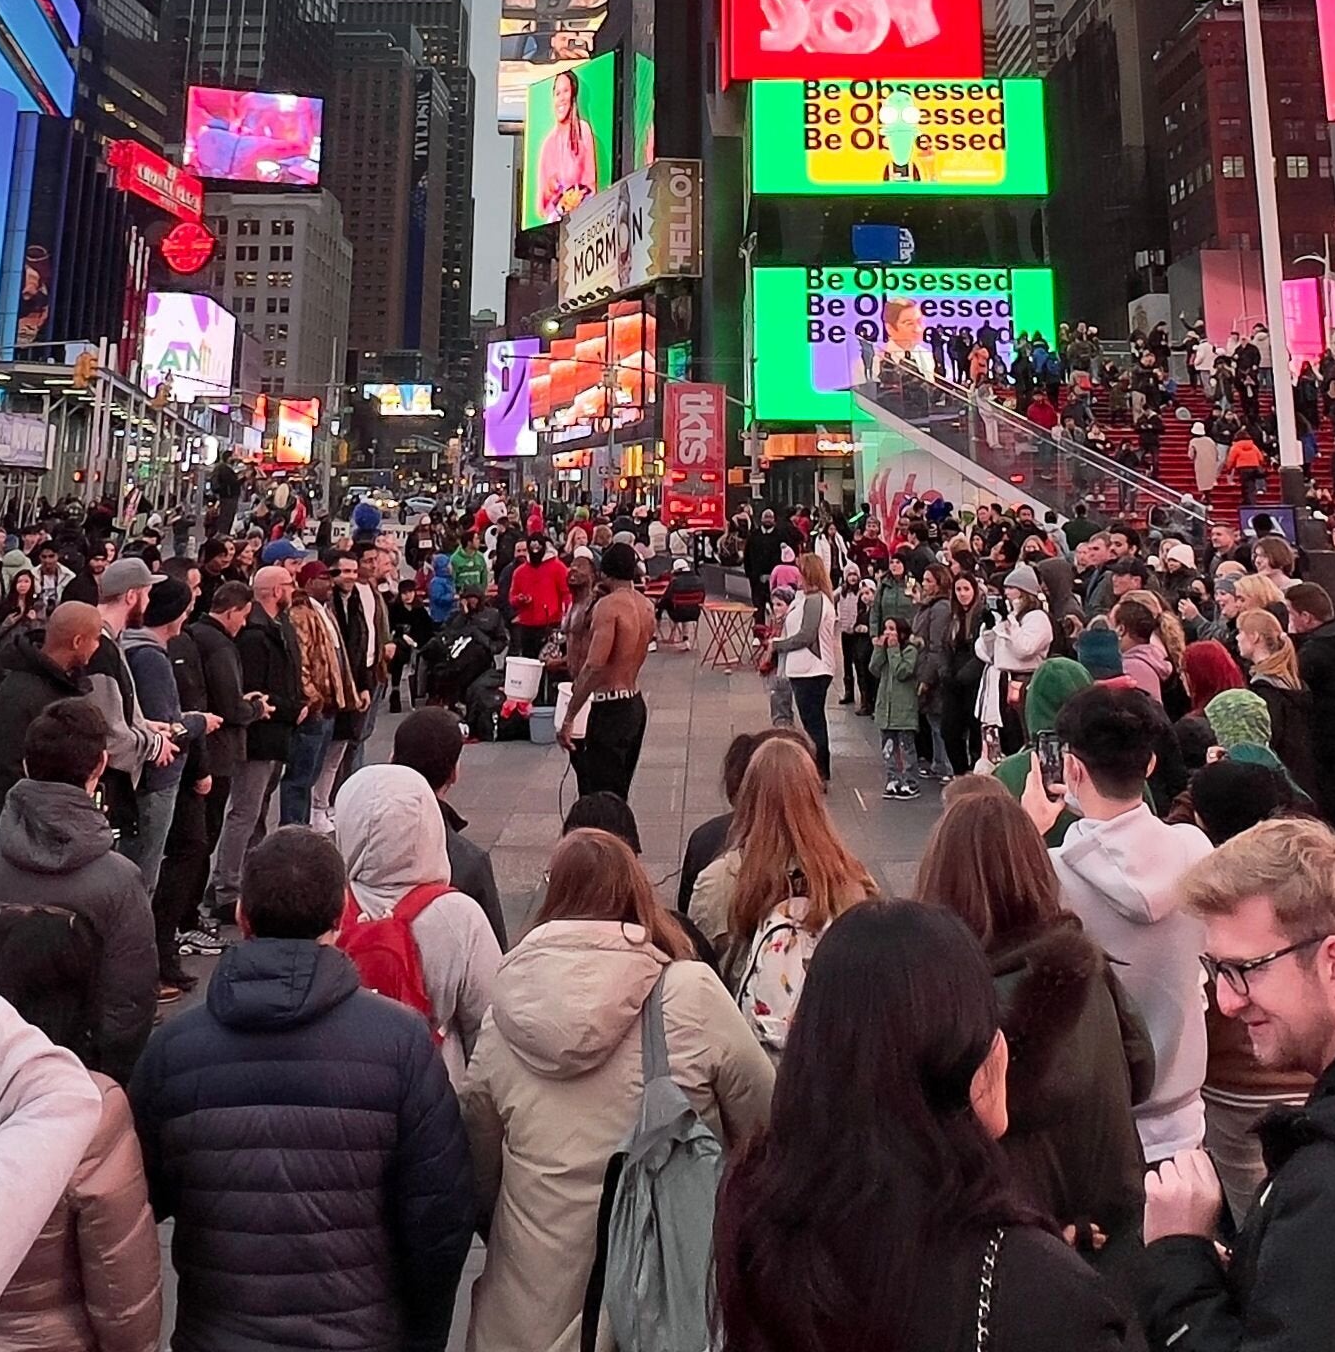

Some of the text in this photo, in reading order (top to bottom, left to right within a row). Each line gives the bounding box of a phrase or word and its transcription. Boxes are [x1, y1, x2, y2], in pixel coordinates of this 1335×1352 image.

[804, 79, 1004, 101] Be Obsessed
[804, 103, 1005, 126] Be Oessed
[804, 127, 1007, 151] Be Obessed
[574, 209, 616, 251] THE BOOK OF
[669, 167, 693, 270] HELLO!
[807, 267, 1013, 292] Be Obsessed
[807, 294, 1014, 318] Be Oessed
[807, 320, 846, 344] Be
[678, 390, 715, 466] tkts
